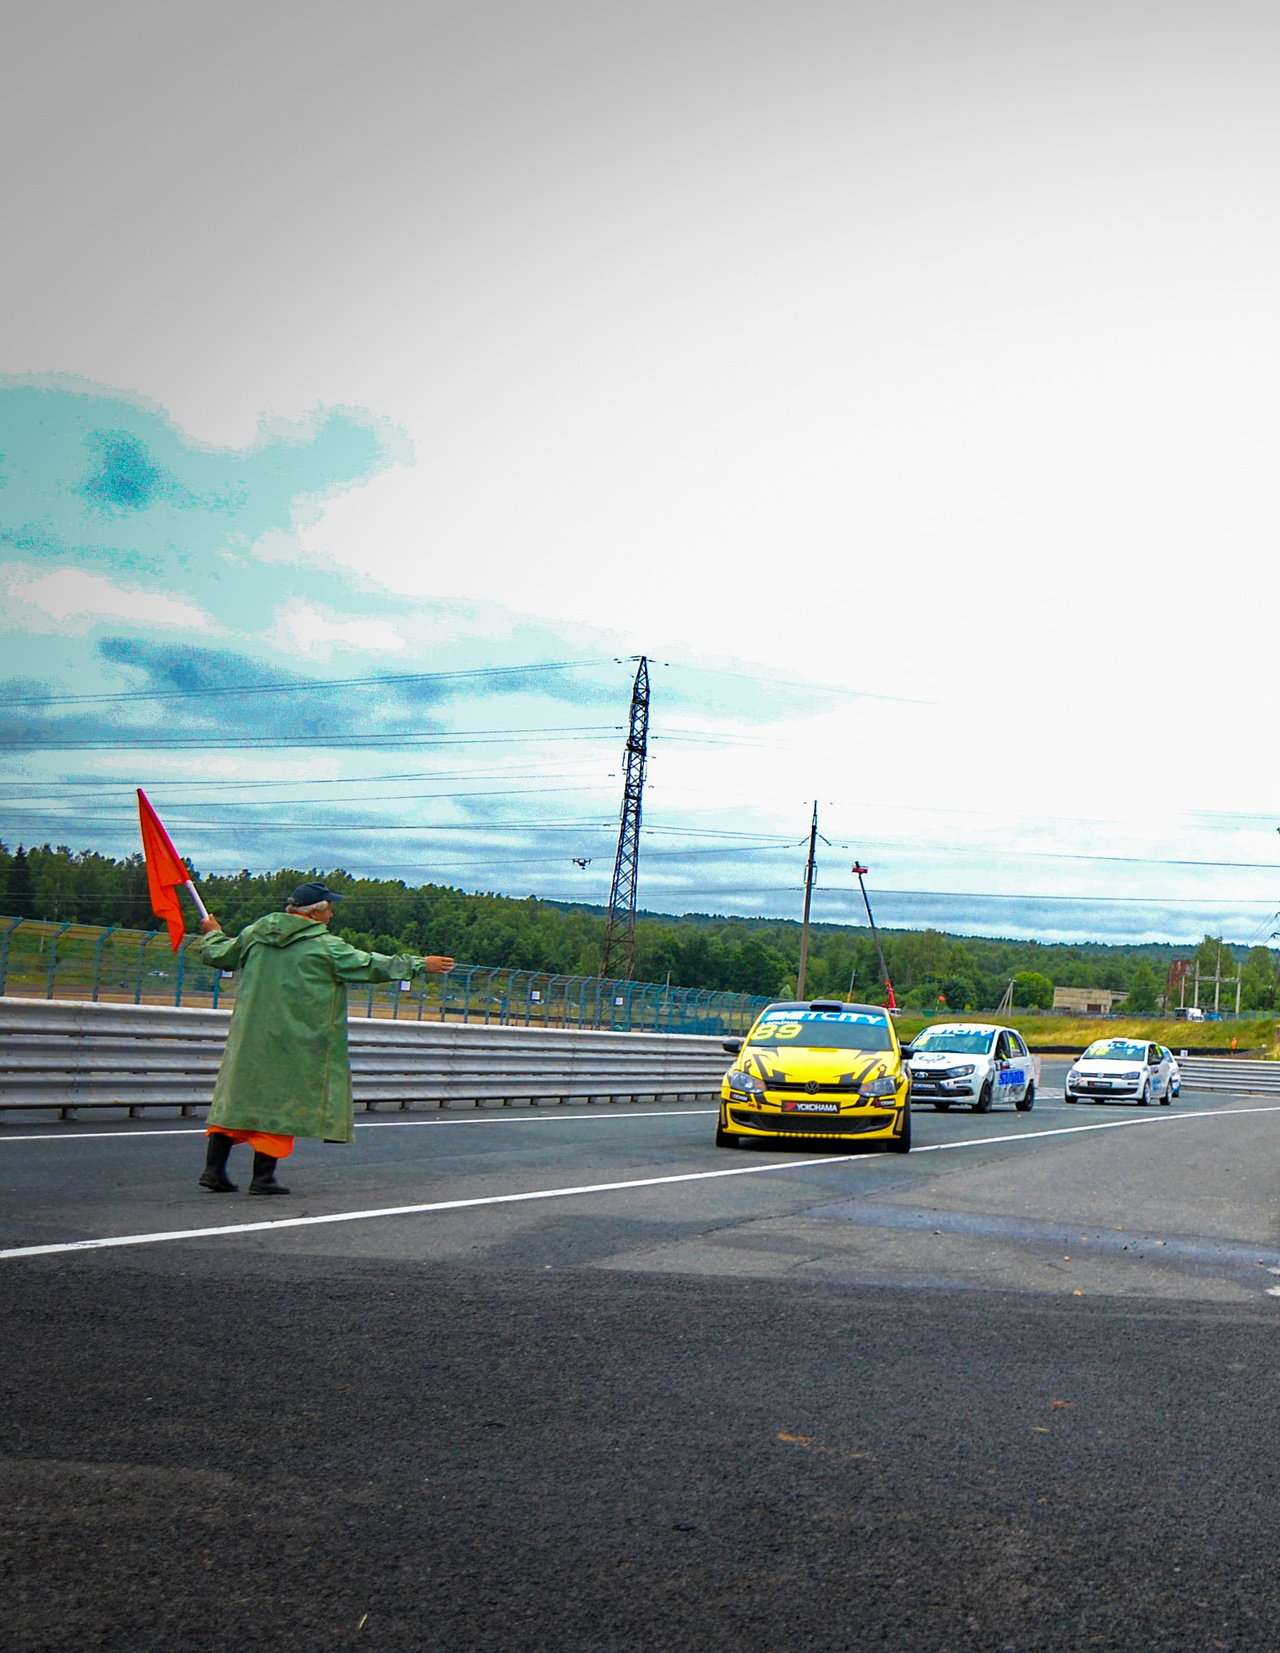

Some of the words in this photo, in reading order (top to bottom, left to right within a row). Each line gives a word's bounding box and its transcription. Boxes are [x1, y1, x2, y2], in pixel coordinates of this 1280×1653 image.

[765, 1011, 883, 1025] BETCITY
[750, 1024, 803, 1041] 89
[796, 1103, 838, 1112] YOKOHAMA
